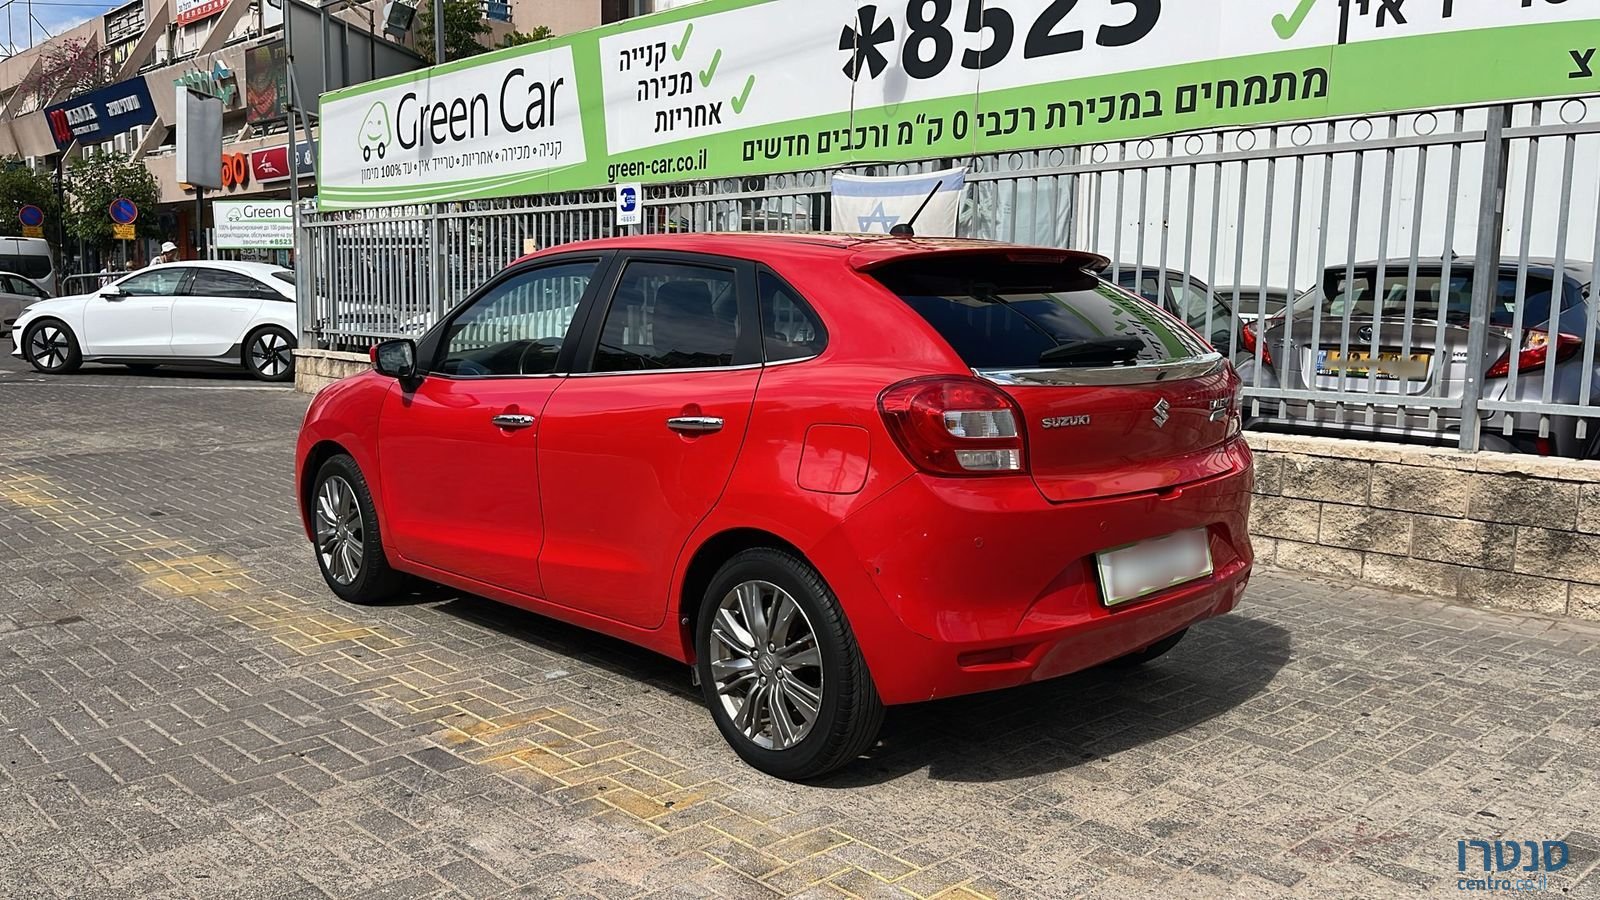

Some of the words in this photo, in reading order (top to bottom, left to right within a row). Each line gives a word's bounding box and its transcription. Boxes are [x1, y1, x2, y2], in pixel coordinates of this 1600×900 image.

[619, 41, 667, 72] קנייה
[638, 71, 693, 102] מכירה
[1175, 67, 1328, 114] מתמחים
[396, 92, 489, 150] Green
[499, 68, 564, 133] Car
[655, 101, 723, 133] אחריות
[976, 106, 1035, 137] רכבי
[1045, 90, 1162, 130] במכירת
[817, 124, 888, 154] ורכבים
[952, 110, 968, 140] 0
[461, 150, 494, 168] אחריות
[501, 145, 531, 162] מכירה
[539, 140, 562, 160] קניה
[742, 134, 809, 162] חדשים
[360, 167, 379, 185] מימון
[381, 163, 402, 178] 100%
[403, 161, 413, 175] עד
[418, 159, 430, 177] אין
[432, 155, 455, 171] טרייד
[607, 148, 708, 183] green-car.co.il
[243, 204, 281, 218] Green
[1041, 414, 1091, 429] SUZUKI
